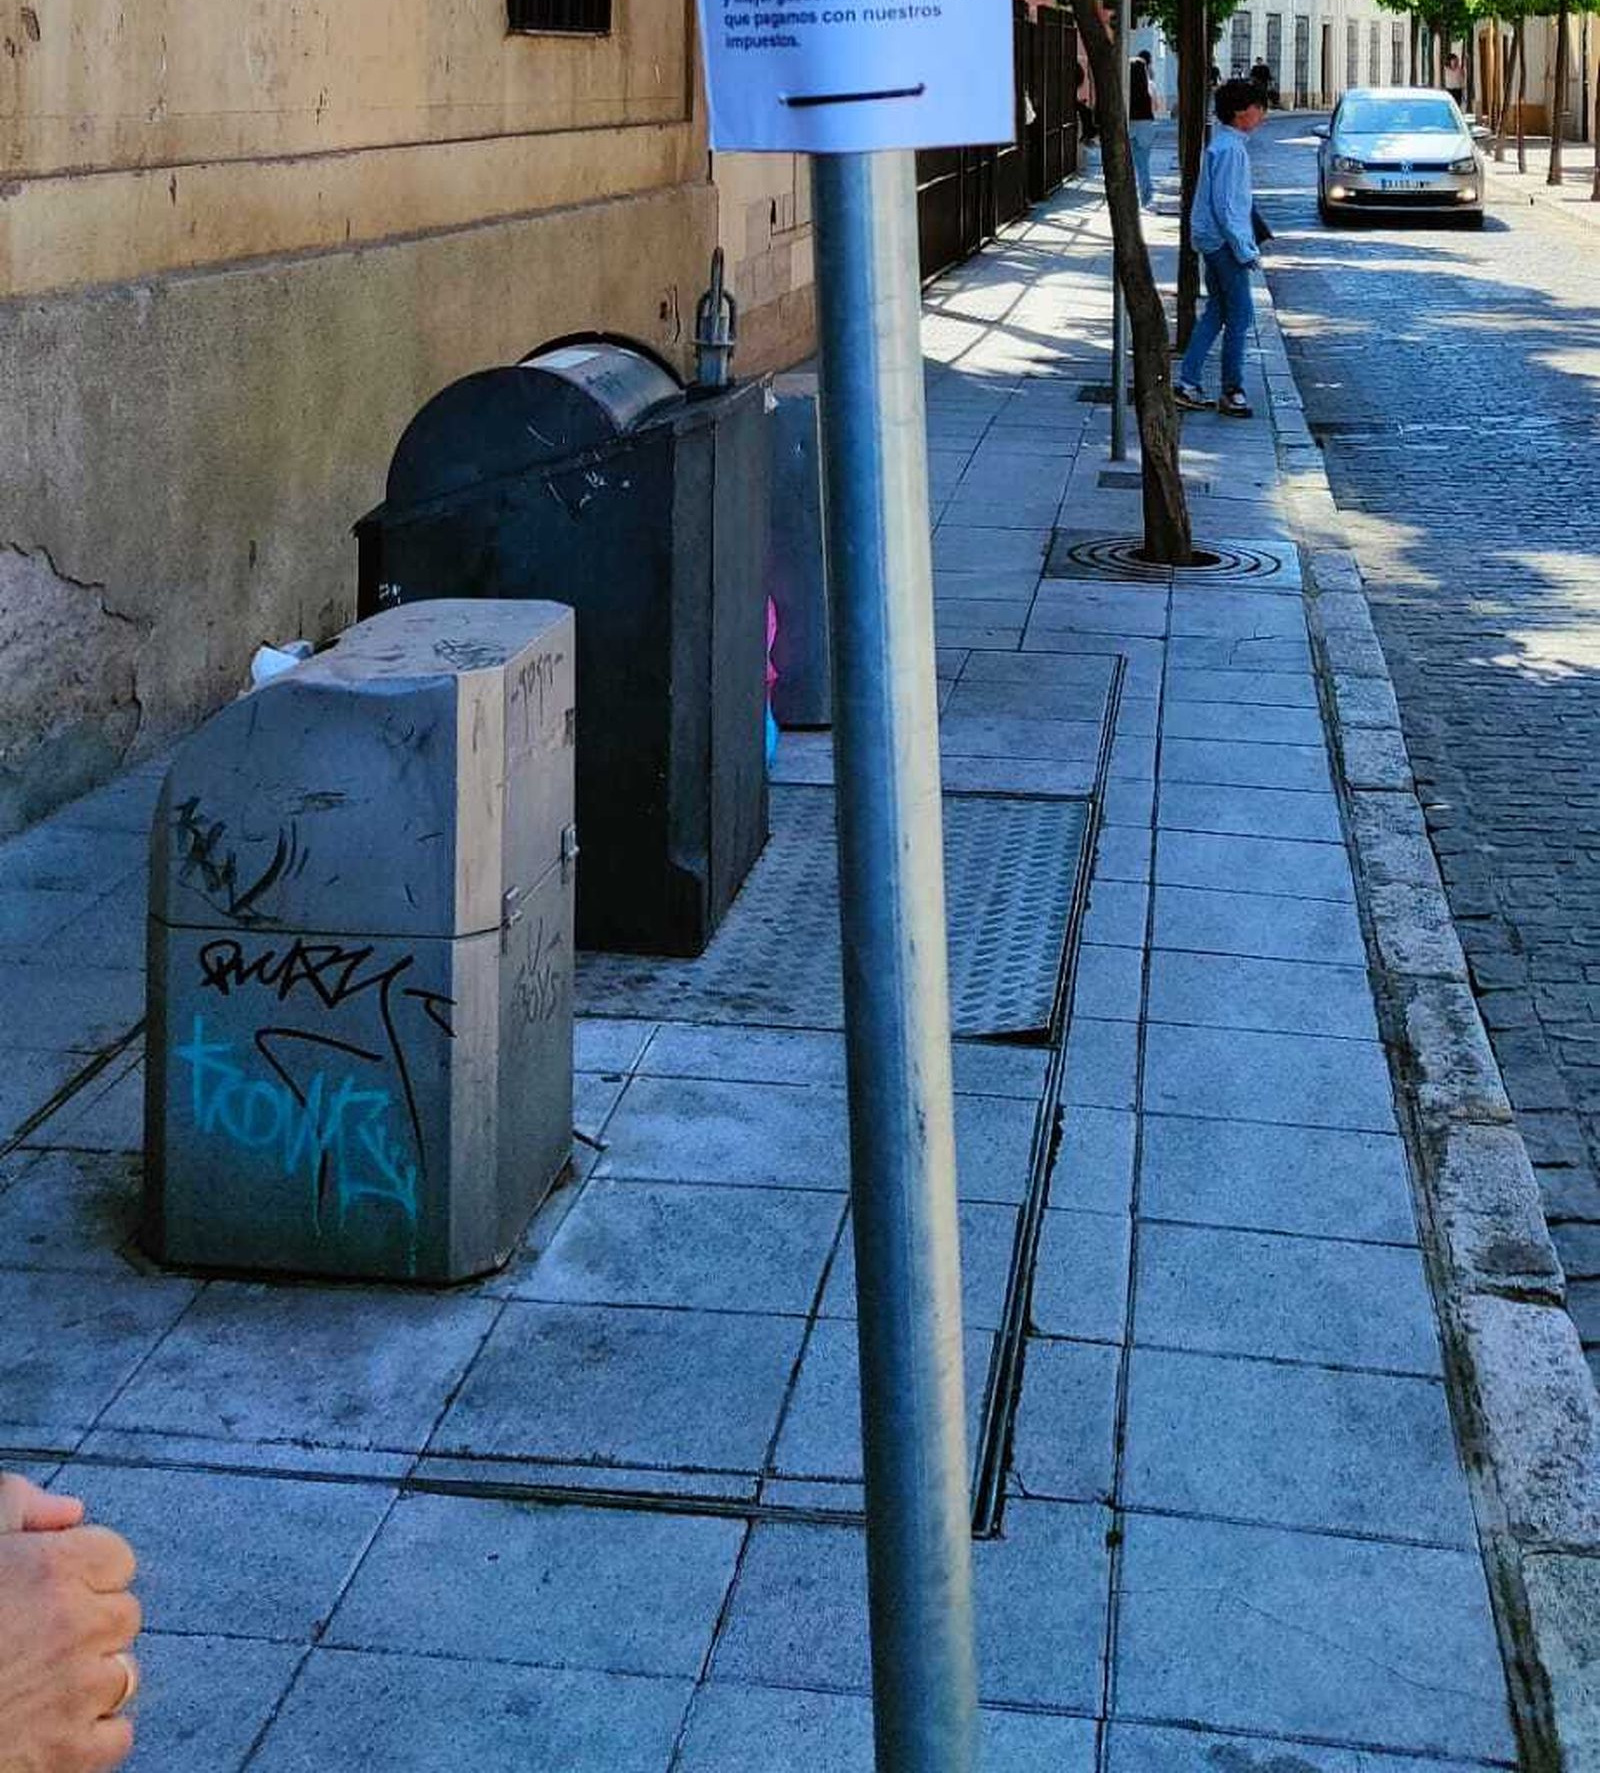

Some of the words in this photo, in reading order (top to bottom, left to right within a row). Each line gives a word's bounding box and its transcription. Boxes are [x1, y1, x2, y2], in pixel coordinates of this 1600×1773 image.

[723, 11, 751, 30] que
[754, 9, 818, 29] pagamos
[821, 8, 856, 24] con
[862, 4, 943, 23] nuestros
[725, 34, 803, 52] impuestos.
